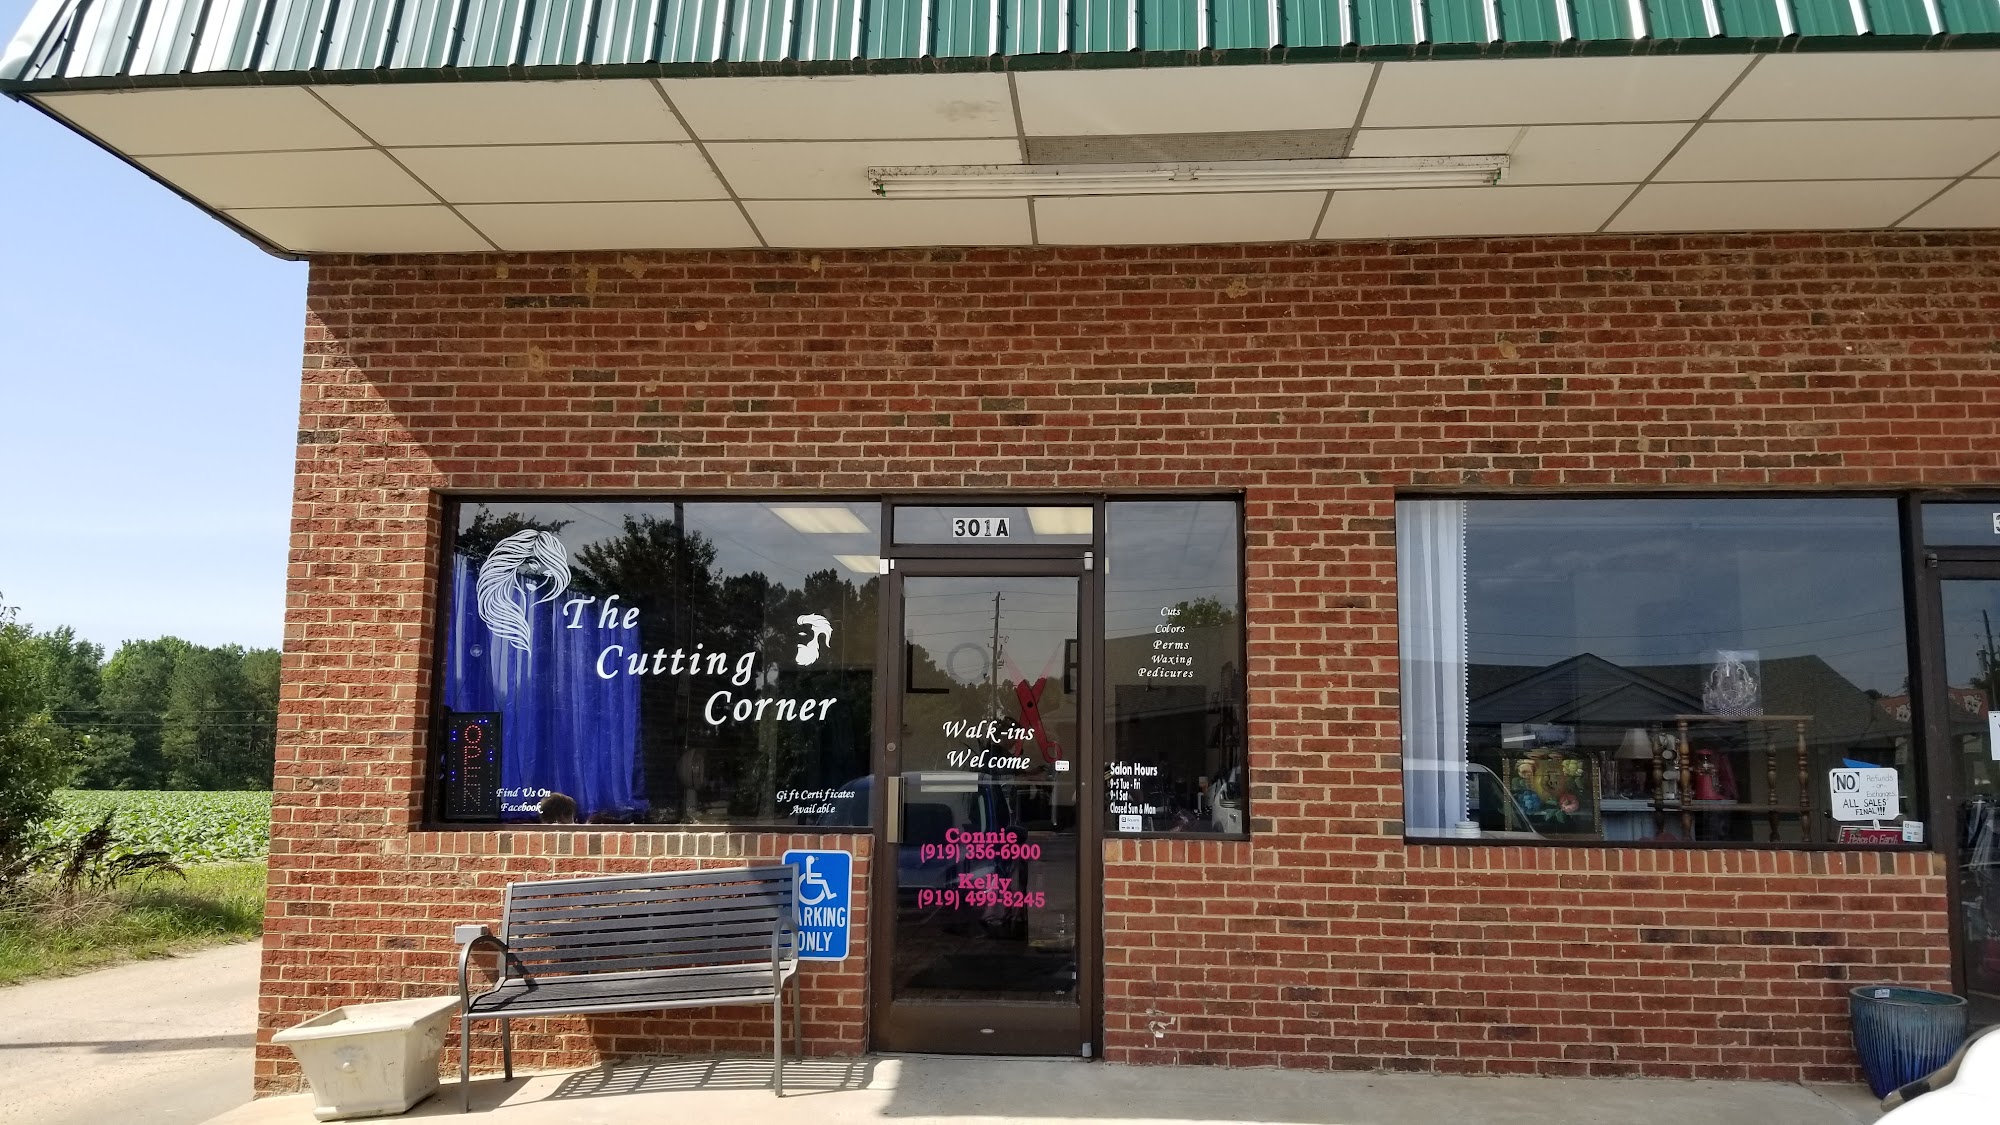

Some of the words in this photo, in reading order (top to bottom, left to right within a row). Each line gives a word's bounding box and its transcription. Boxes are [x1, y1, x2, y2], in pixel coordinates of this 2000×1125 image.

[954, 518, 1009, 537] 301A
[563, 595, 640, 630] The
[1161, 607, 1181, 616] Cuts
[1155, 623, 1186, 633] Colors
[1152, 640, 1190, 650] Perms
[596, 642, 756, 686] Cutting
[1151, 654, 1193, 666] Waxing
[1137, 667, 1194, 678] Pedicures
[705, 690, 837, 726] Corner
[942, 719, 1035, 743] Walk-ins
[463, 724, 482, 807] OPEN
[947, 749, 1031, 770] Welcome
[1110, 761, 1132, 776] Salon
[1133, 762, 1158, 776] Hours
[1109, 778, 1119, 789] 9-5
[1120, 778, 1130, 790] Tue
[1133, 778, 1141, 790] Fri
[1836, 774, 1857, 791] NO
[1866, 774, 1894, 782] Refunds
[496, 788, 519, 798] Find
[522, 787, 536, 798] Us
[537, 788, 552, 798] On
[776, 789, 800, 802] Gift
[801, 788, 856, 801] Certificates
[1109, 789, 1119, 801] 9-1
[1119, 790, 1128, 801] Sat
[500, 802, 544, 814] Facebook
[789, 803, 836, 815] Available
[1109, 801, 1127, 814] Closed
[1128, 802, 1139, 814] Sun
[1144, 803, 1157, 814] Mon
[1842, 799, 1859, 809] ALL
[1863, 798, 1887, 808] SALES
[945, 827, 1018, 844] Connie
[920, 843, 961, 863] (919)
[965, 844, 1041, 860] 356-6900
[958, 873, 1012, 894] Kelly
[917, 889, 960, 910] (919)
[965, 891, 1046, 908] 499-8245
